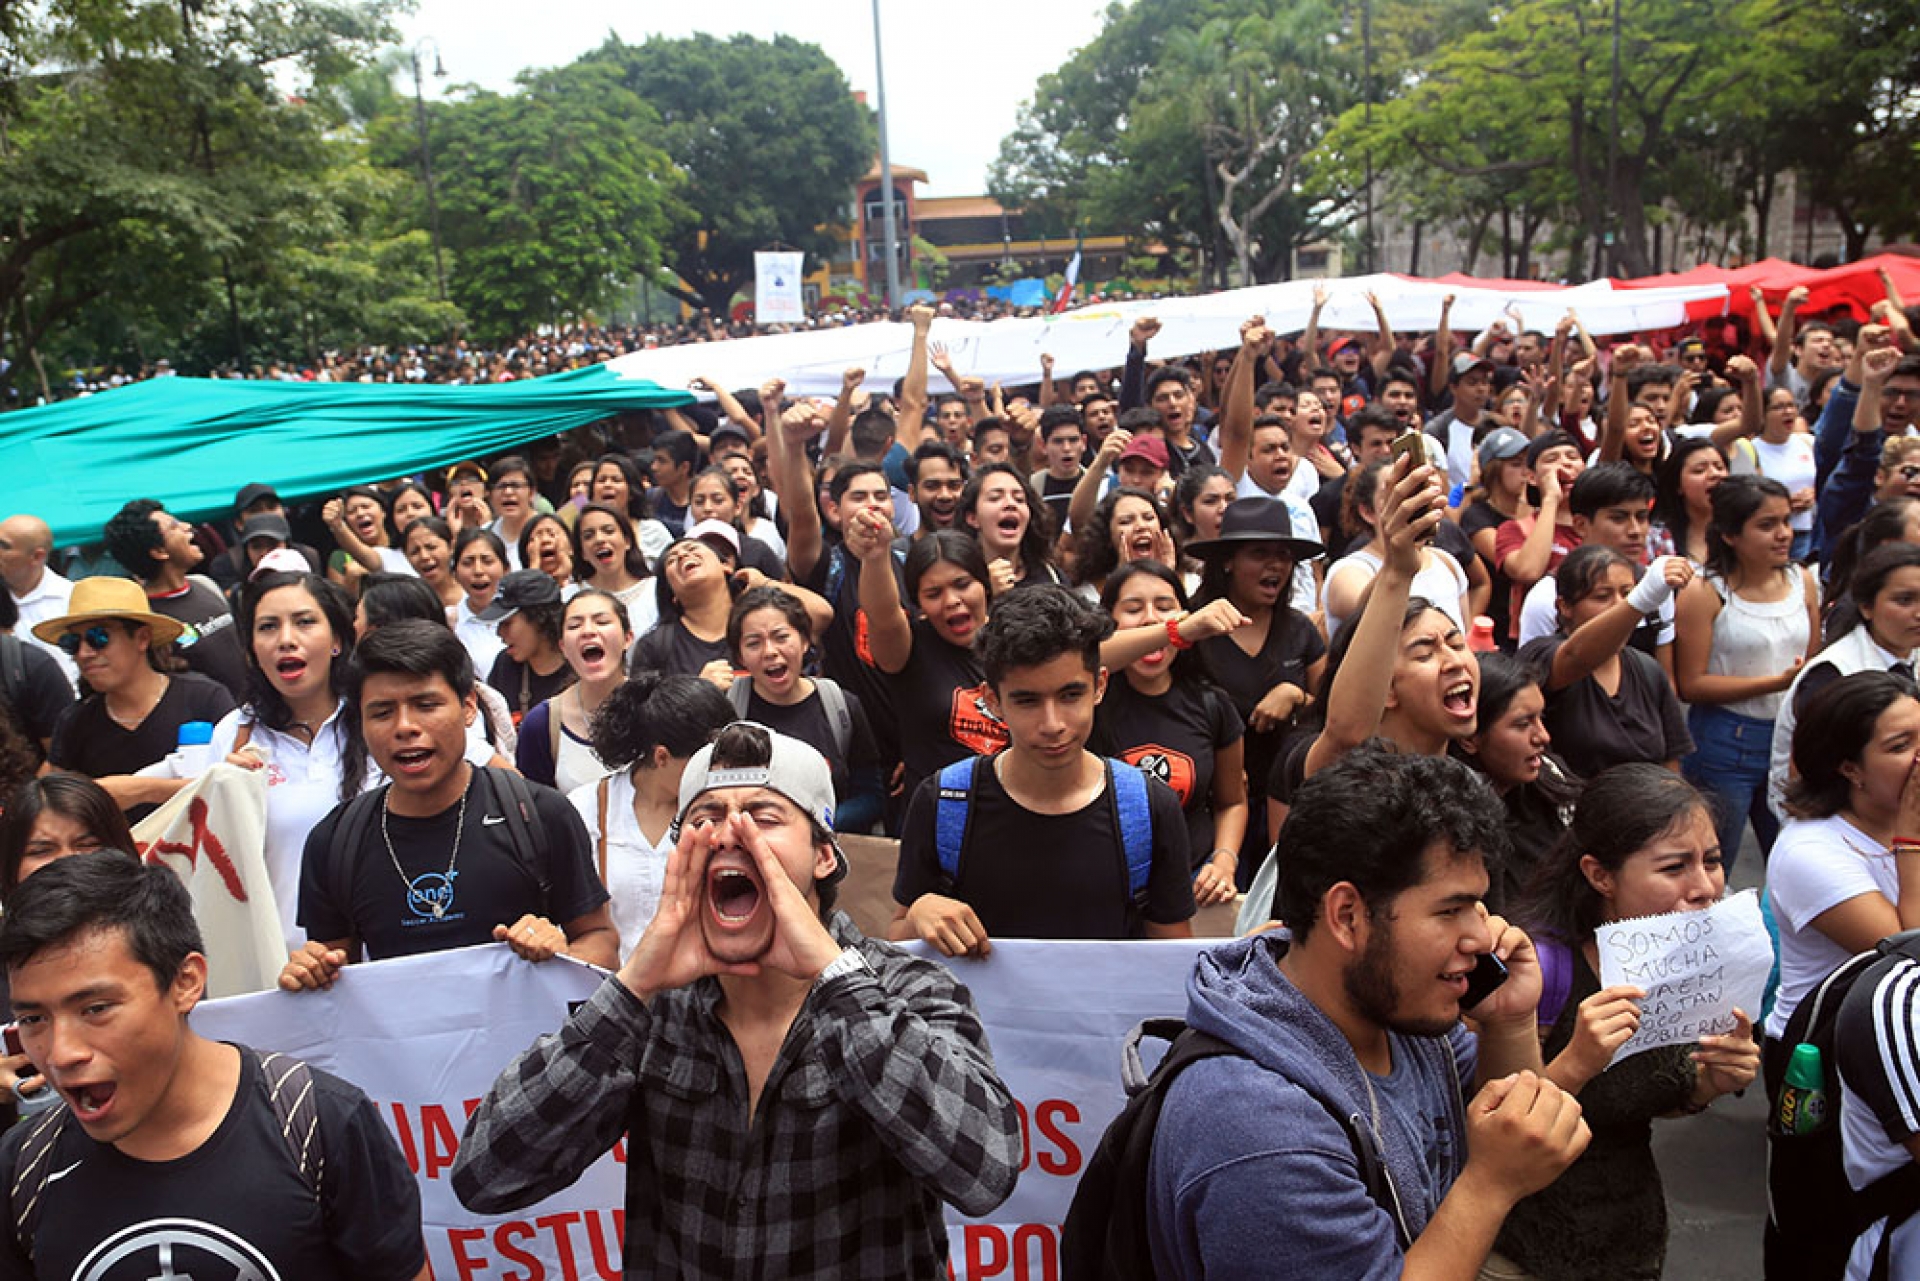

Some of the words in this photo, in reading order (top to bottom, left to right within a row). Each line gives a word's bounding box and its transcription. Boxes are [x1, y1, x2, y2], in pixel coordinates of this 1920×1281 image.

[1607, 915, 1714, 964] SOMOS
[1621, 944, 1720, 983] MUCHA
[1676, 985, 1723, 1011] TAN
